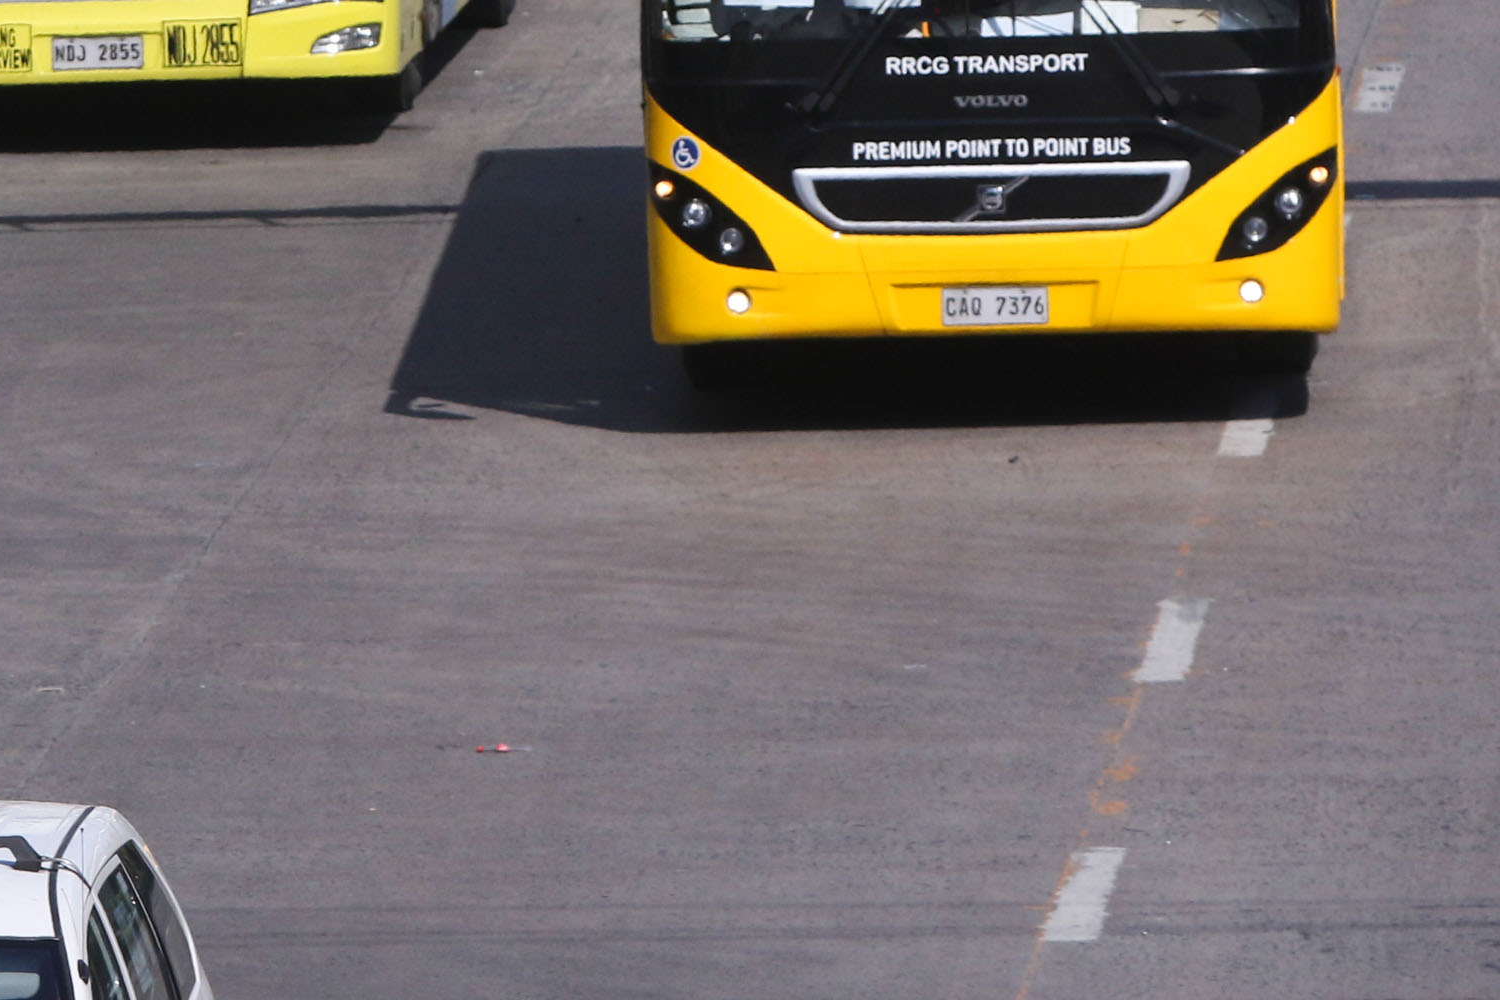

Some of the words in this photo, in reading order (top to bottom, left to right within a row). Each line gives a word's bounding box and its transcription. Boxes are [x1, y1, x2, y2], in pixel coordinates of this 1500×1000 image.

[55, 45, 87, 62] NDJ
[98, 43, 141, 62] 2855
[201, 22, 240, 64] 2855
[885, 55, 950, 76] RRCG
[953, 52, 1090, 75] TRANSPORT
[954, 93, 1029, 109] VOLVO
[852, 139, 941, 161] PREMIUM
[946, 138, 1002, 159] POINT
[1005, 137, 1030, 158] TO
[1032, 136, 1090, 157] POINT
[1092, 136, 1132, 156] BUS
[945, 296, 983, 317] CAQ
[996, 295, 1046, 316] 7376
